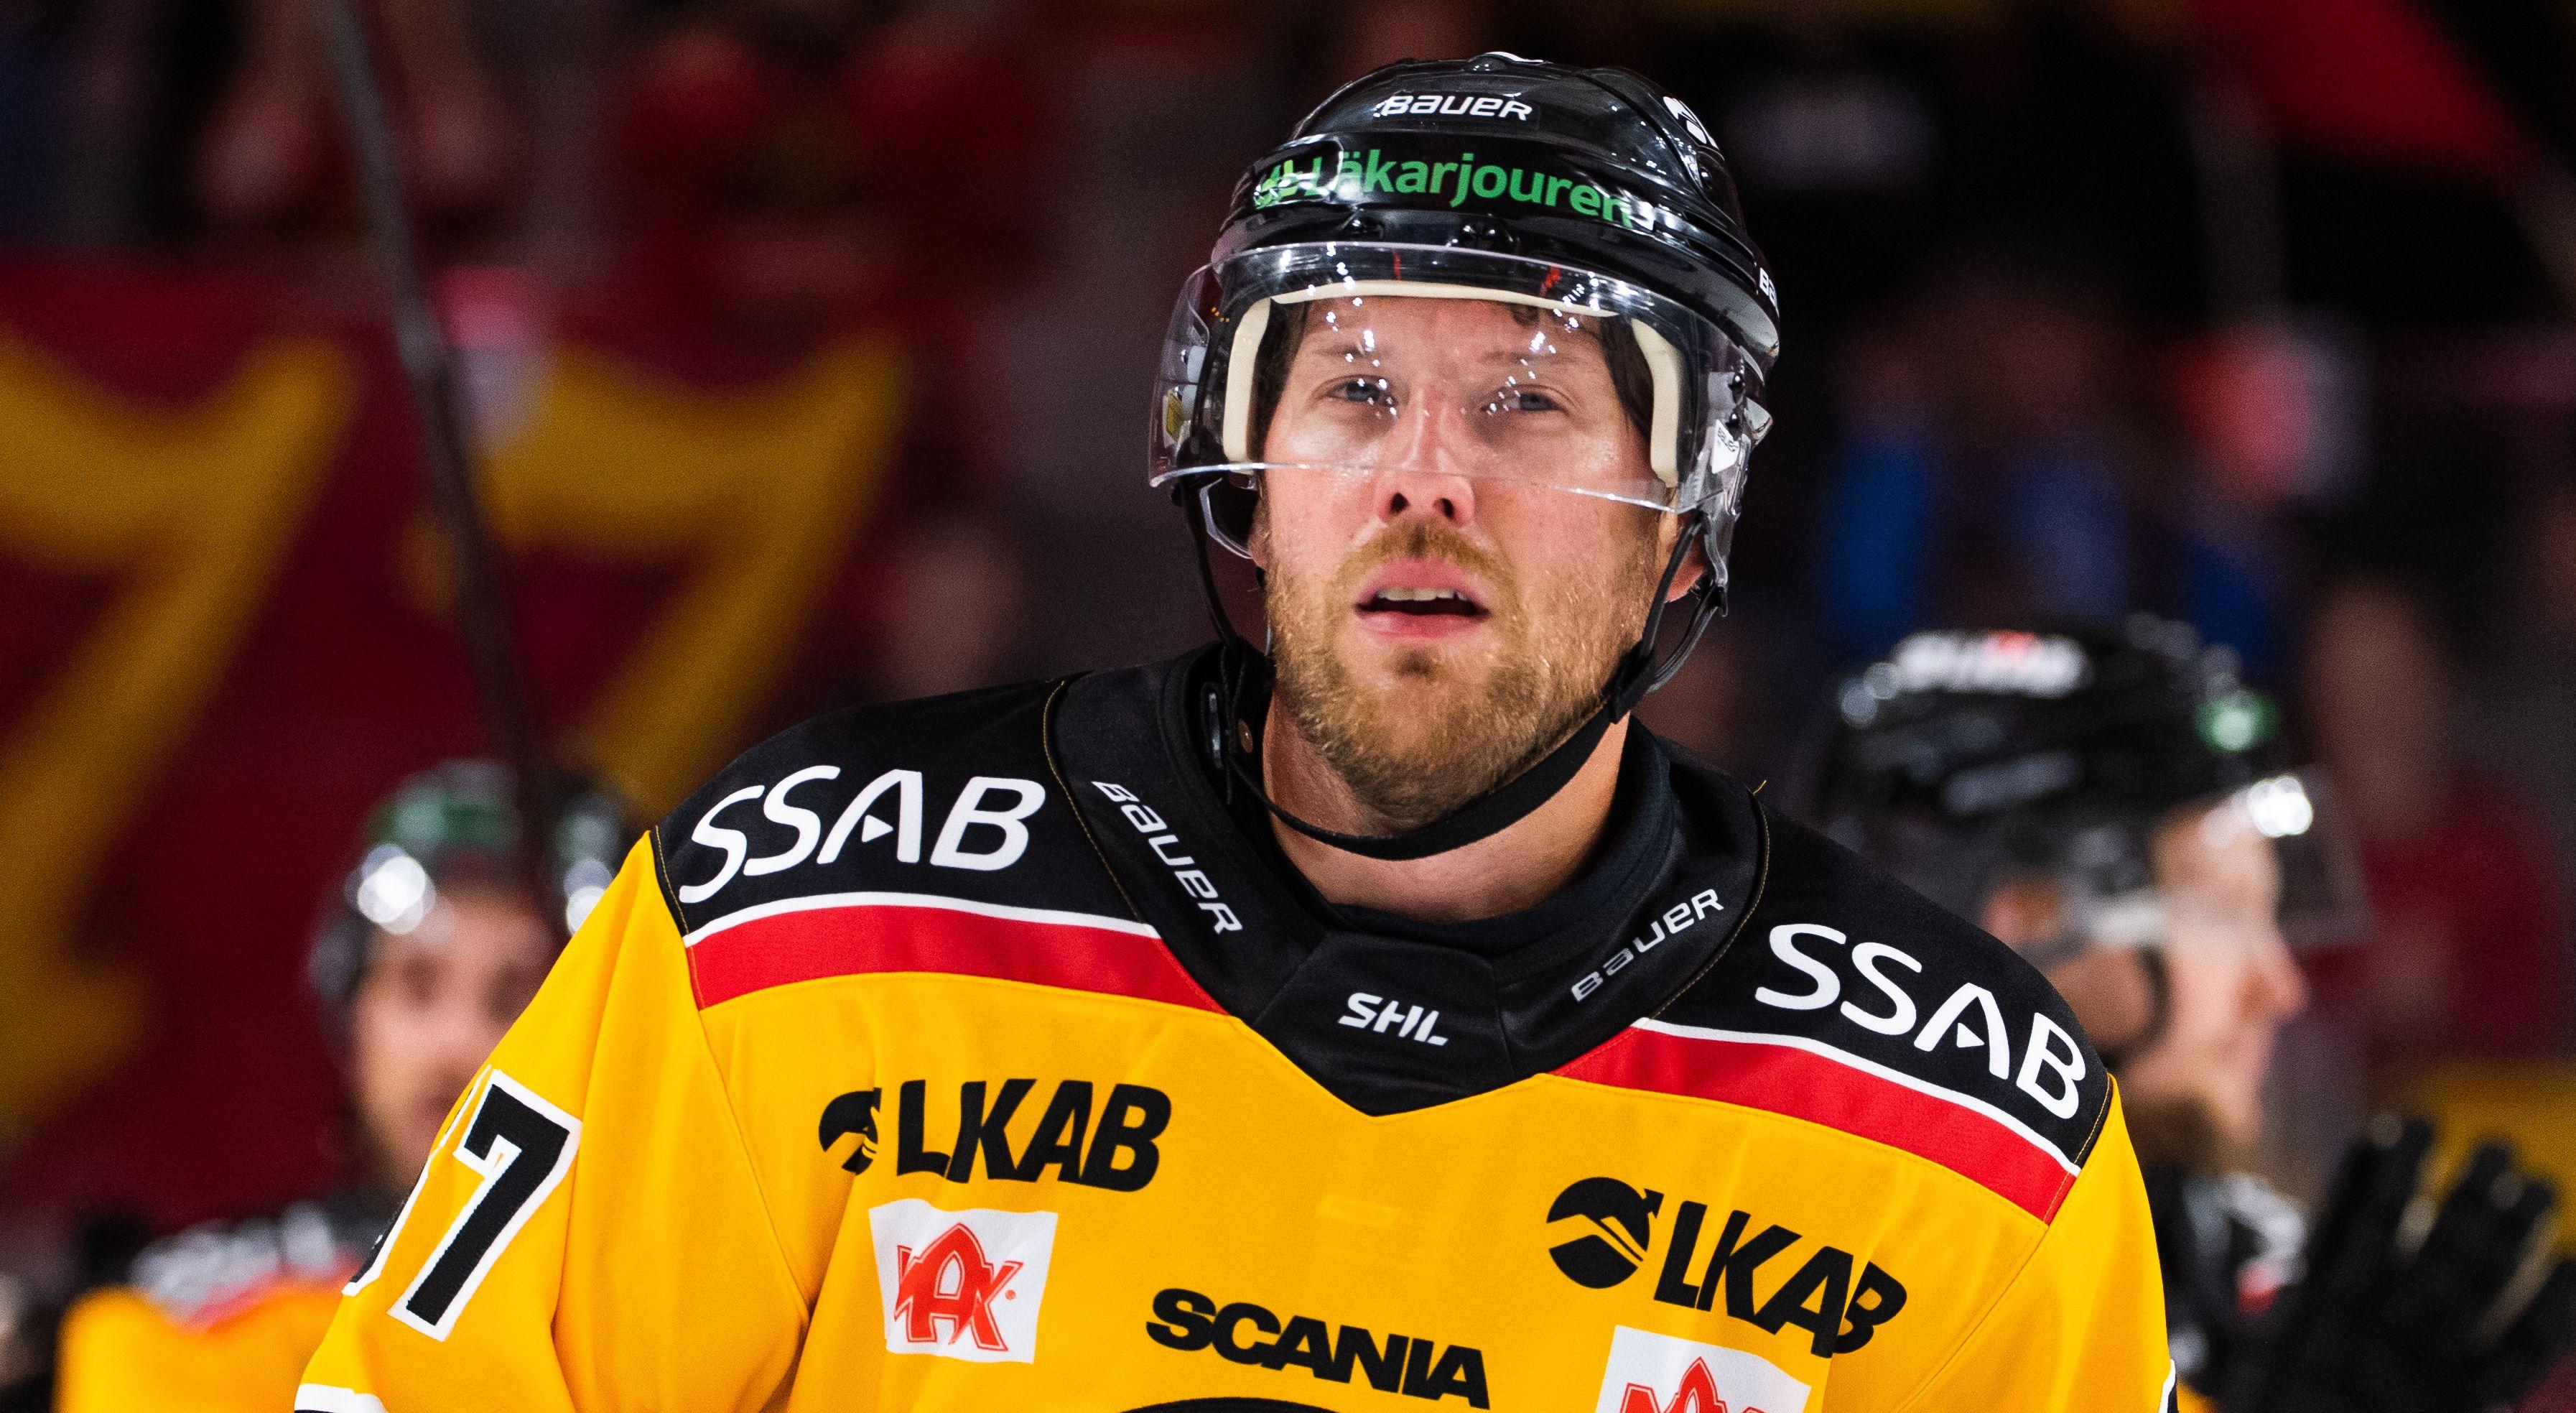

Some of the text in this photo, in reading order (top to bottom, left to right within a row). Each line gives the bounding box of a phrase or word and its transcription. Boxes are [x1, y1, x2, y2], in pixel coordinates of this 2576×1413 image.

[1380, 96, 1533, 121] BAUER
[679, 765, 1046, 903] SSAB
[1092, 781, 1242, 934] BAUER
[1571, 889, 1724, 1001] BAUER
[1338, 992, 1449, 1045] SHL
[1755, 922, 2086, 1119] SSAB
[897, 1078, 1171, 1192] LKAB
[342, 1065, 582, 1342] 7
[1652, 1201, 1907, 1358] LKAB
[1145, 1288, 1490, 1410] SCANIA
